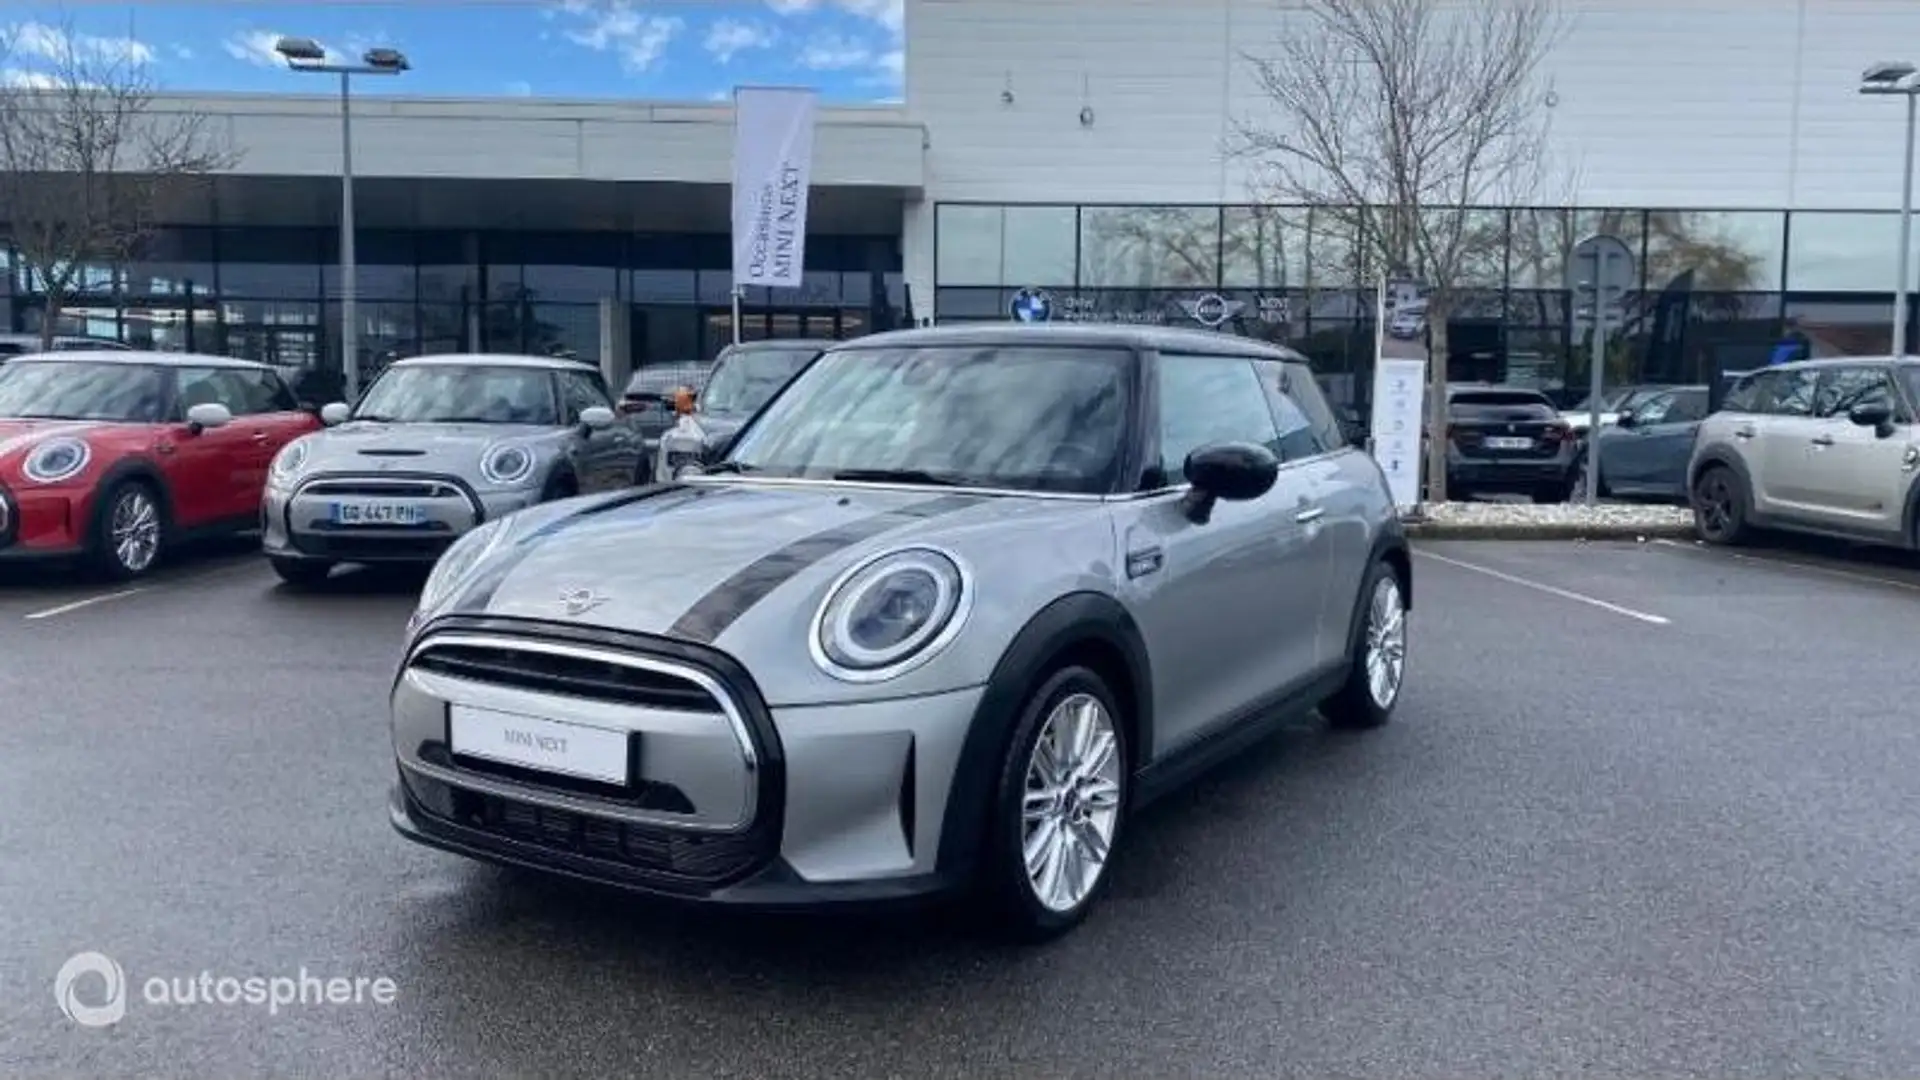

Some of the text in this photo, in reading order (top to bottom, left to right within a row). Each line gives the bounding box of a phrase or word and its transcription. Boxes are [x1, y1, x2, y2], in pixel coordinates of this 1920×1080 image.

[775, 161, 799, 278] MINI NEXT
[504, 729, 567, 754] MINI NEXT
